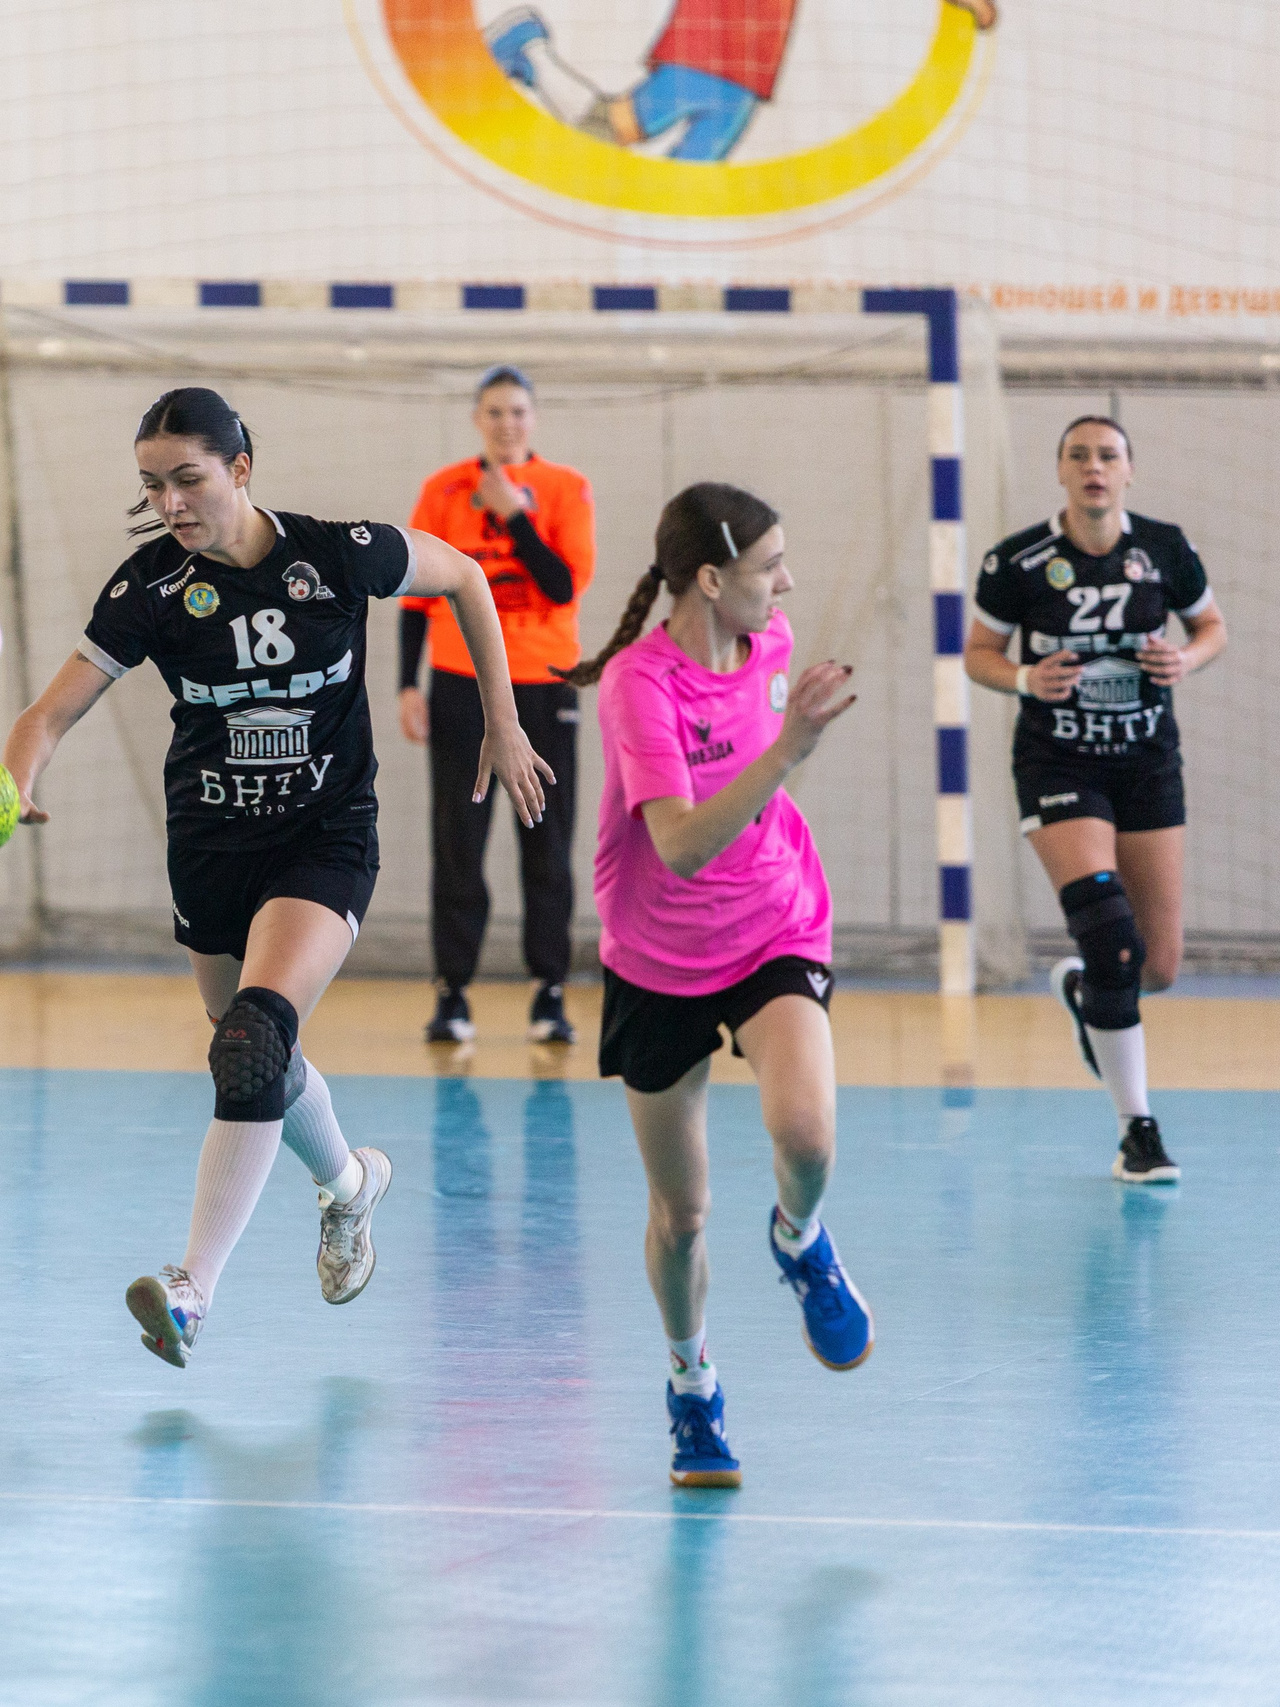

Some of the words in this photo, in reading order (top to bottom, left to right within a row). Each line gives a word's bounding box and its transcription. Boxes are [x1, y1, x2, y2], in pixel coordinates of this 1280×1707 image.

[1067, 583, 1133, 633] 27
[228, 608, 295, 669] 18
[180, 649, 353, 707] BELAZ
[1052, 705, 1163, 742] БНТУ
[199, 754, 334, 807] БНТУ
